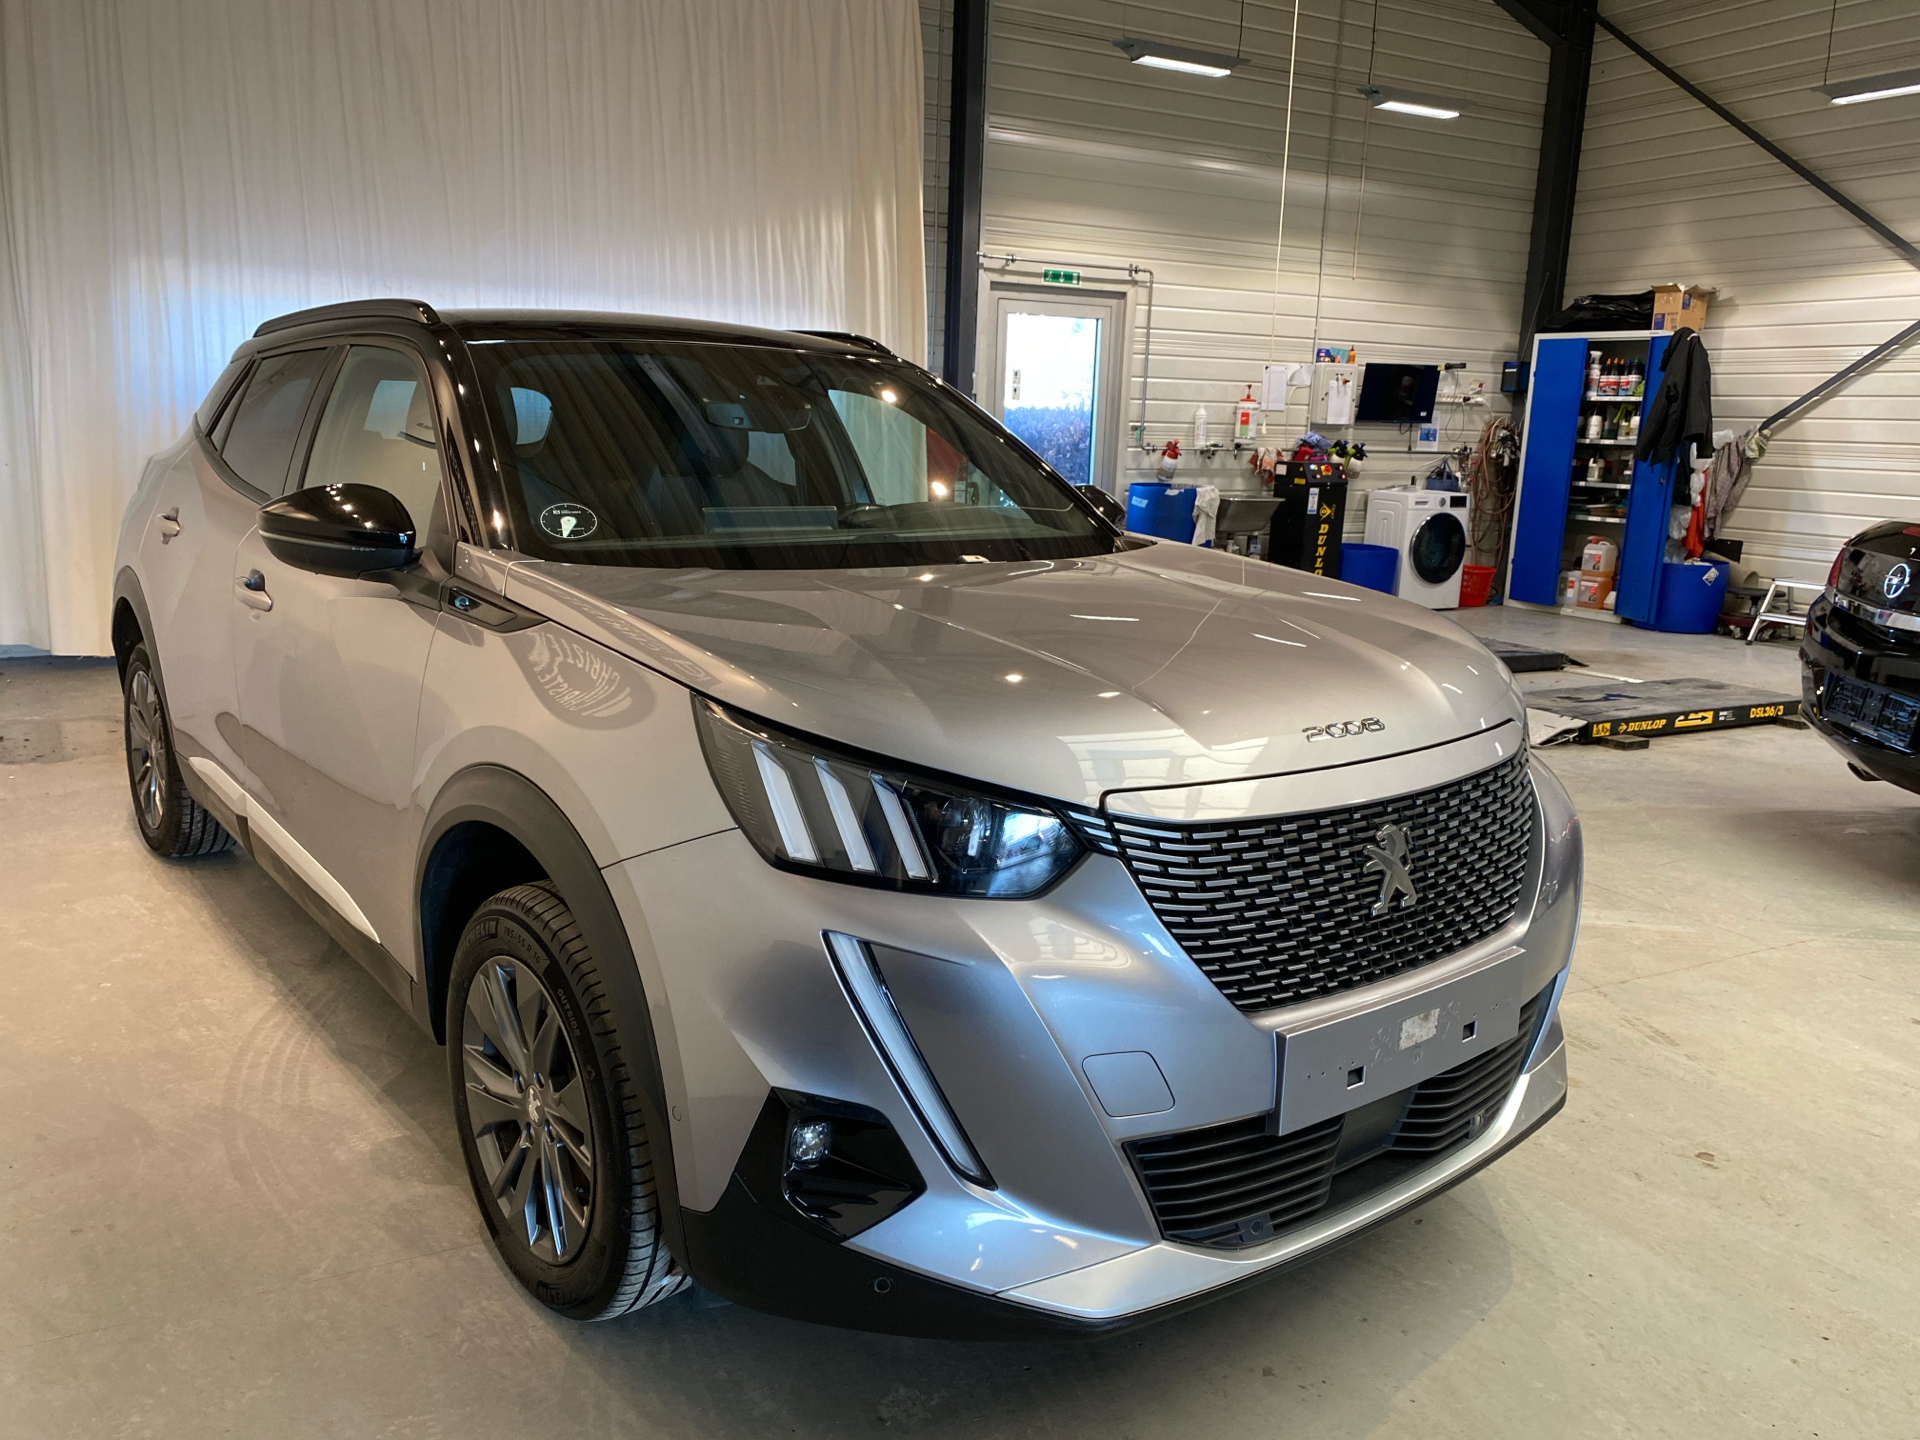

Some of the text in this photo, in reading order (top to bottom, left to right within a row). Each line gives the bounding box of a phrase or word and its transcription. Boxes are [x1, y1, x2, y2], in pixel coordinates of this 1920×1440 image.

[1749, 705, 1784, 719] DSL36/3
[1302, 717, 1386, 743] 2008
[1627, 719, 1667, 732] DUNLOP
[504, 926, 526, 948] 195/55
